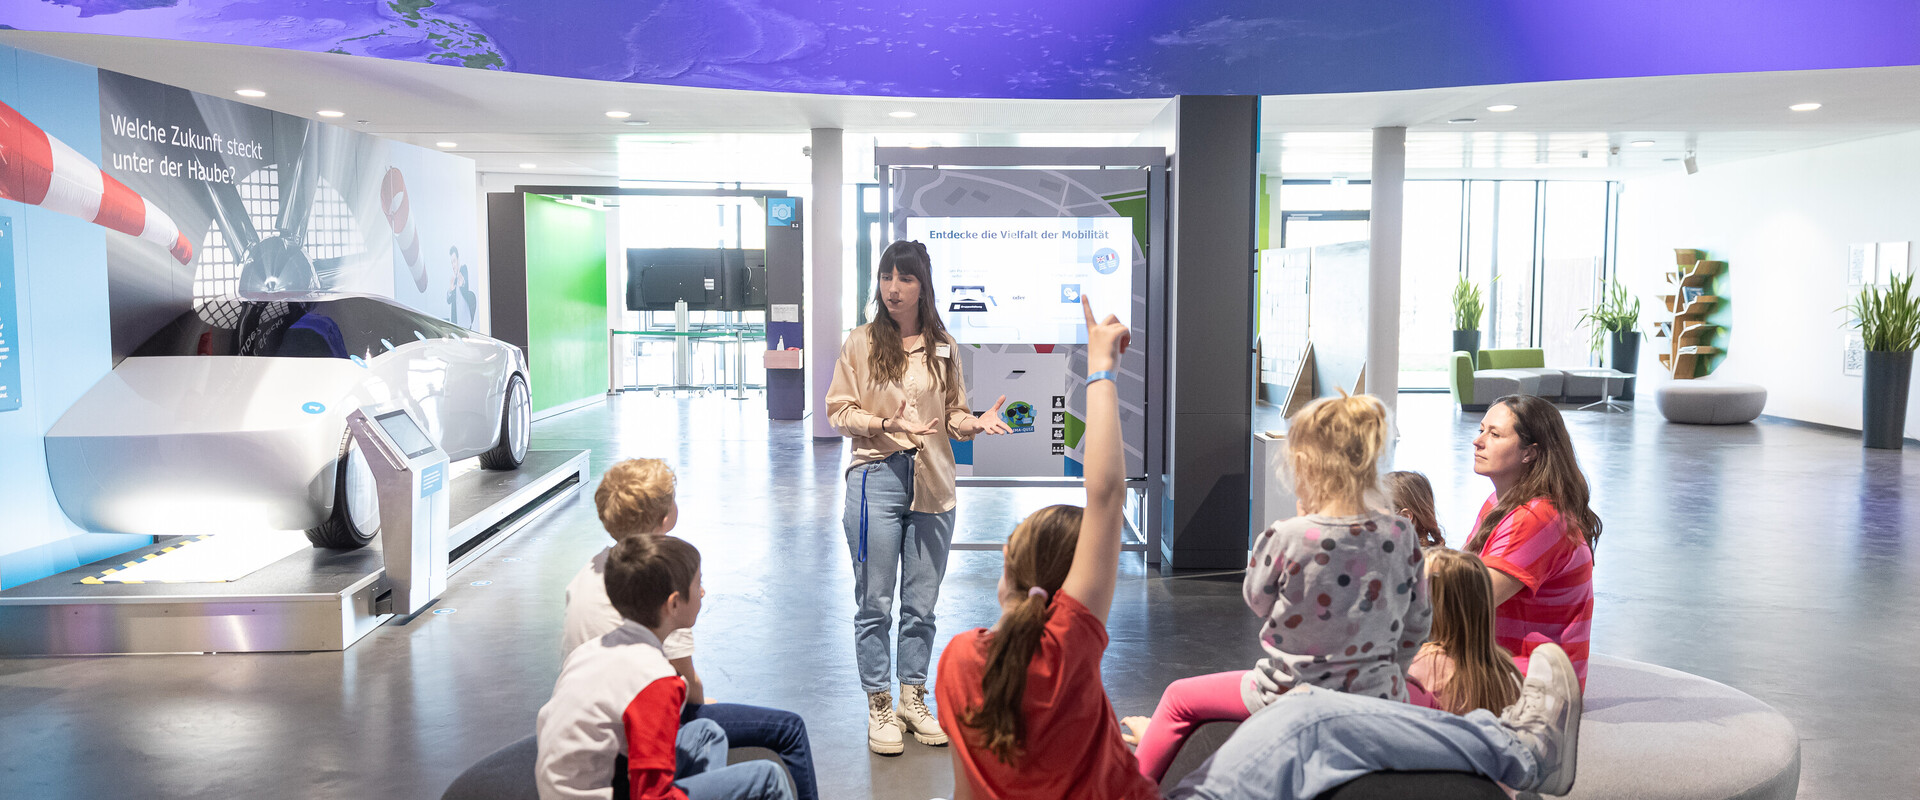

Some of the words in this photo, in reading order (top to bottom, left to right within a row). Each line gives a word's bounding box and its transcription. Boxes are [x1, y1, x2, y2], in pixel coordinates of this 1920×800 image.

[111, 113, 166, 143] Welche
[171, 125, 223, 153] Zukunft
[227, 138, 263, 160] steckt
[113, 152, 154, 174] unter
[159, 155, 183, 177] der
[188, 159, 236, 185] Haube?
[929, 230, 978, 239] Entdecke
[981, 230, 998, 239] die
[1000, 230, 1039, 239] Vielfalt
[1041, 230, 1059, 239] der
[1062, 230, 1110, 239] Mobilität
